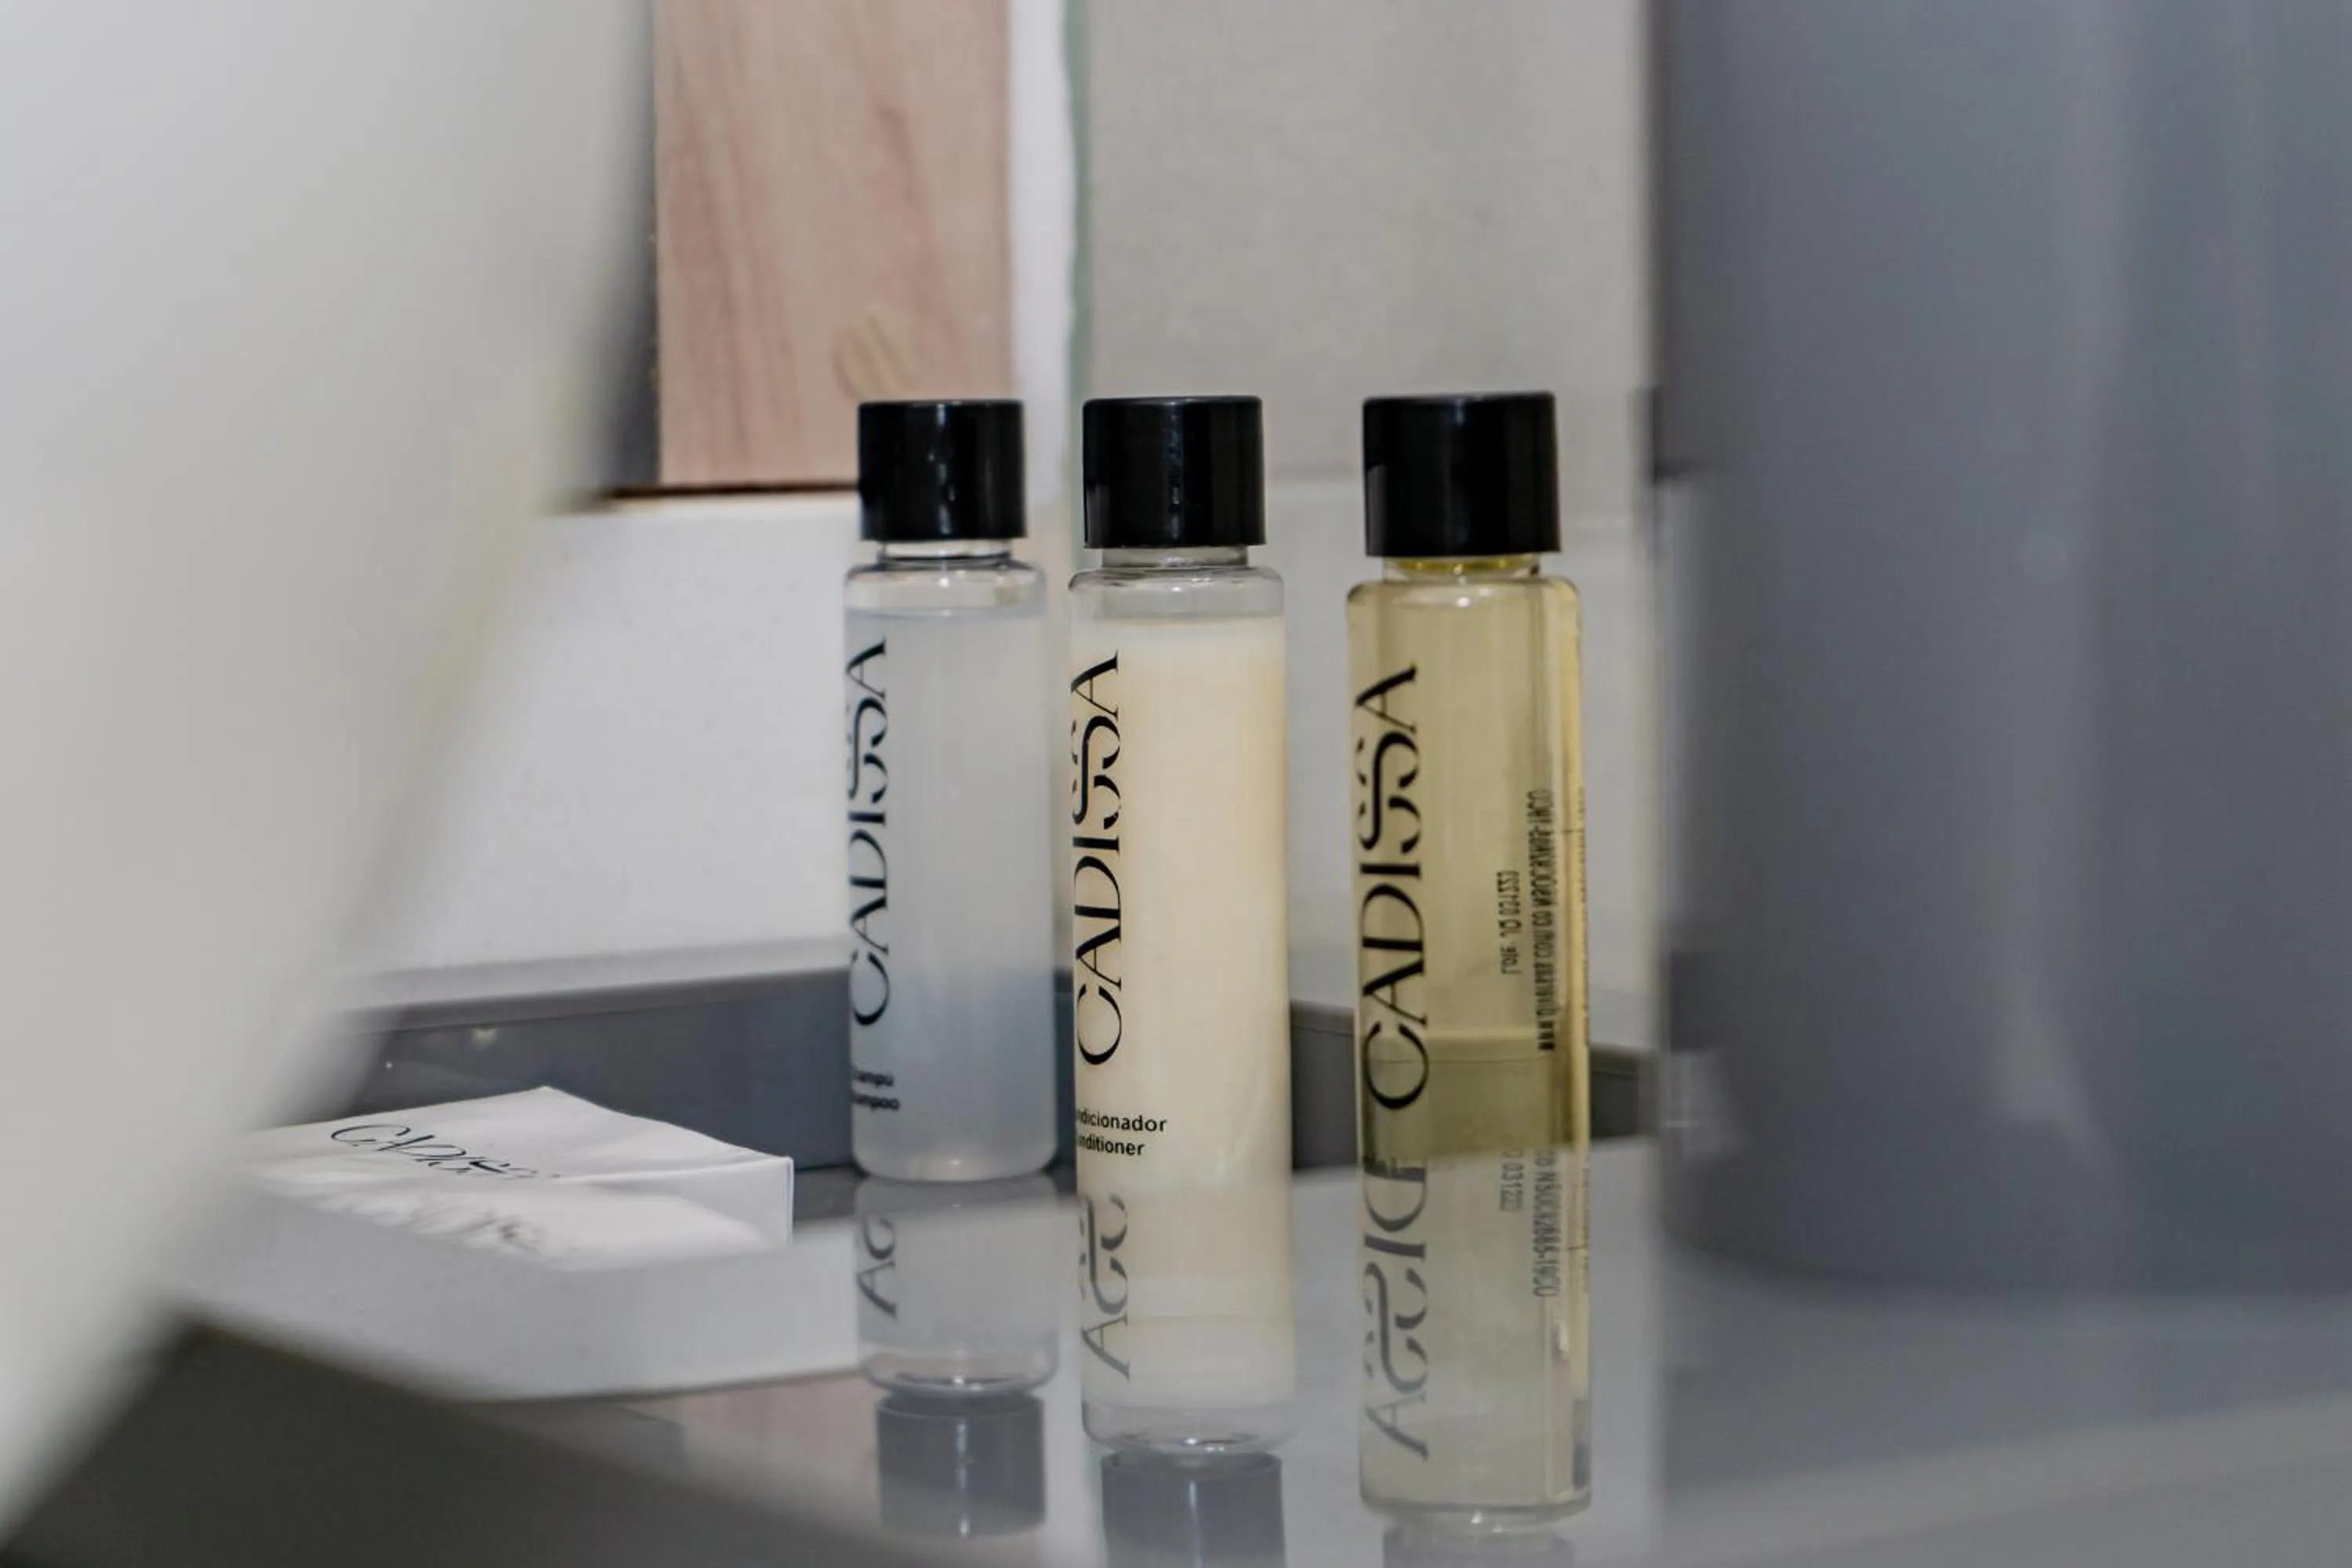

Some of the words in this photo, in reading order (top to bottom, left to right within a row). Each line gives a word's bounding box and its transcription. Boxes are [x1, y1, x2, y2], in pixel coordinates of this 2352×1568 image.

[1070, 650, 1122, 1065] CADISSA
[1355, 664, 1429, 1110] CADISSA
[1076, 1108, 1167, 1133] ndicionador
[1077, 1134, 1145, 1156] nditioner
